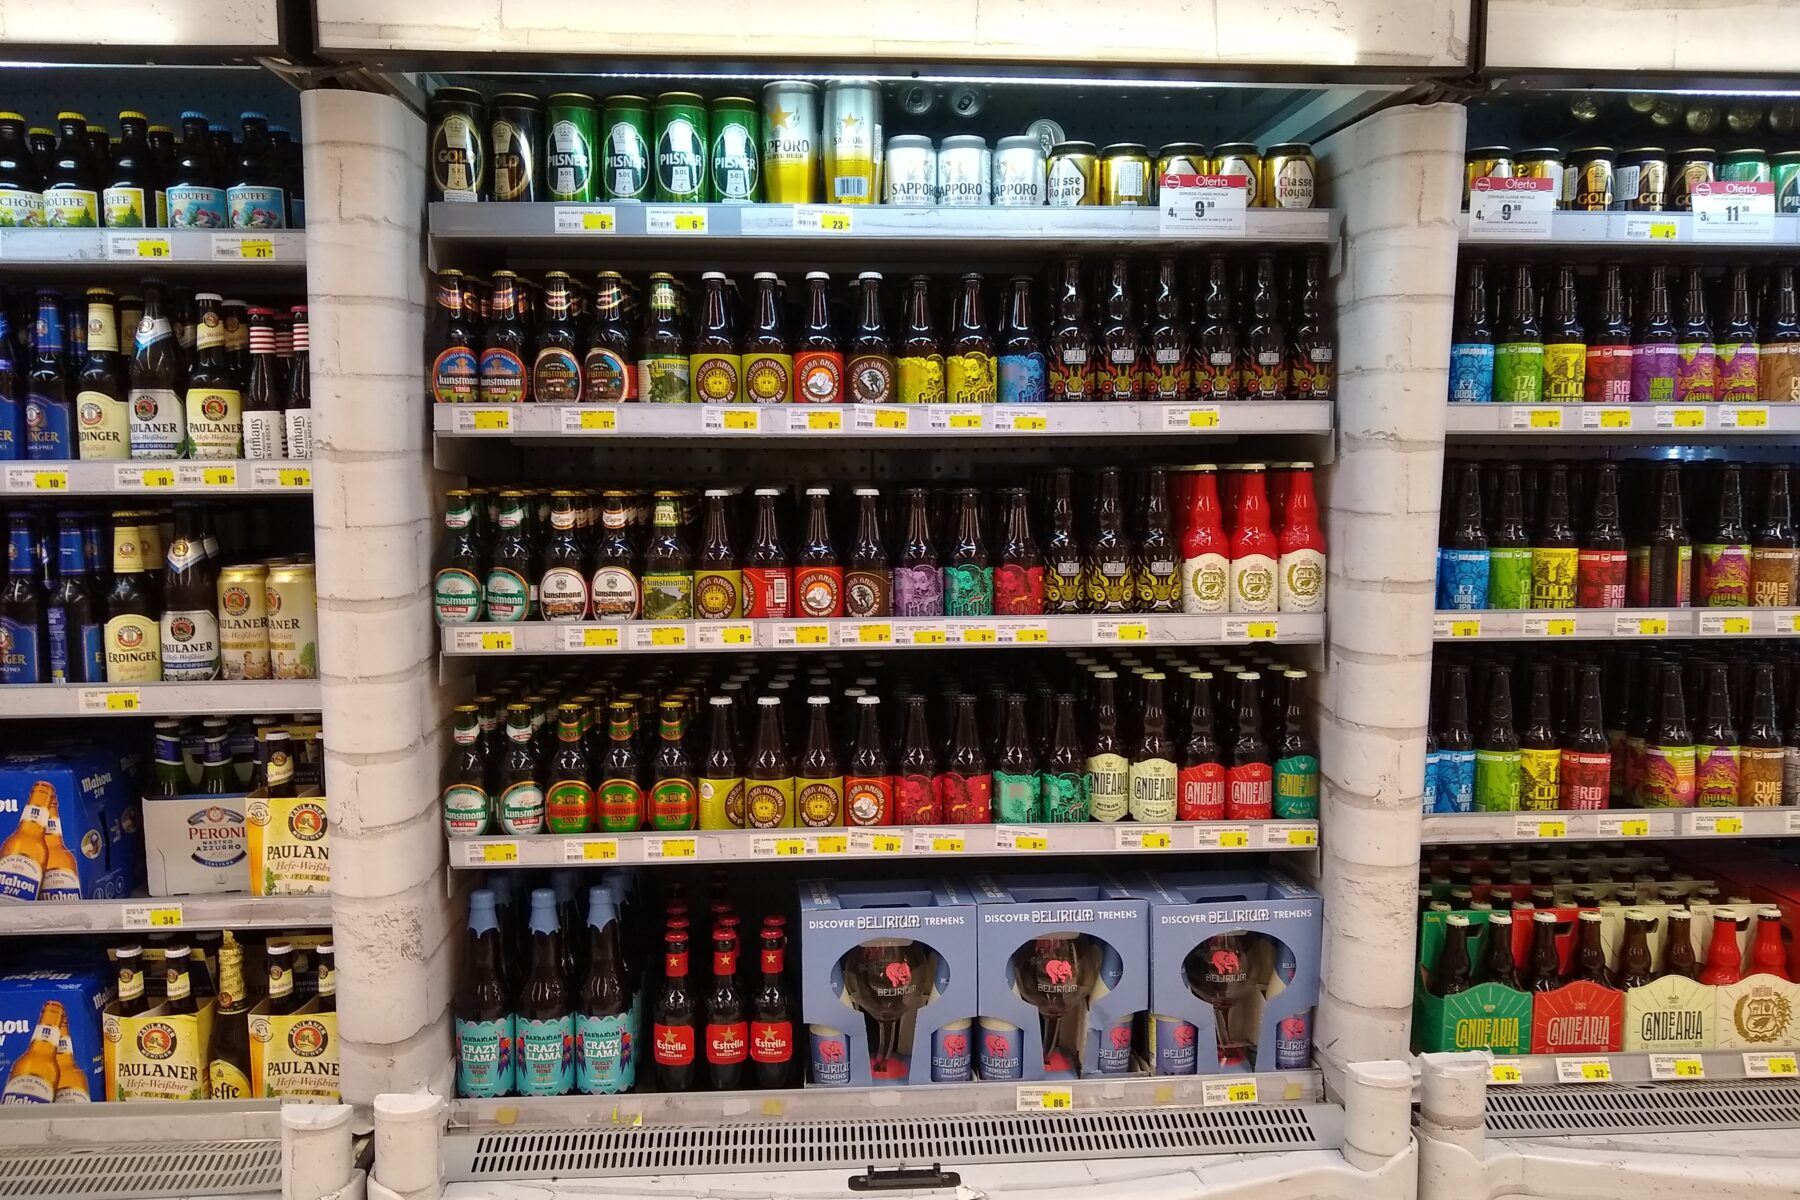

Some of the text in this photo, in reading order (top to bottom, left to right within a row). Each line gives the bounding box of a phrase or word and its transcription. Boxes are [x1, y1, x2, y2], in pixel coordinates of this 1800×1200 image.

[660, 155, 702, 167] PILSNER
[1196, 176, 1228, 186] Oferta
[1279, 176, 1313, 187] Classe
[1506, 178, 1536, 189] Oferta
[1279, 187, 1313, 199] Royale
[1726, 183, 1757, 193] Oferta
[1578, 193, 1613, 205] GOLD
[1459, 379, 1473, 389] K-7
[1514, 376, 1536, 389] 174
[1614, 380, 1630, 393] RED
[655, 513, 673, 522] IPA
[543, 590, 583, 600] kunstmann
[595, 589, 633, 599] kunstmann
[1458, 585, 1473, 594] K-7
[108, 652, 158, 663] ERDINGER
[82, 772, 112, 793] Mahou
[1580, 786, 1602, 800] RED
[188, 827, 246, 840] PERONI
[4, 886, 20, 896] SIN
[984, 909, 1137, 924] DISCOVER DELIRIUM TREMENS
[1161, 909, 1312, 924] DISCOVER DELIRIUM TREMENS
[808, 915, 965, 930] DISCOVER DELIRIUM TREMENS
[1547, 1015, 1610, 1046] CANDELARIA
[1641, 1010, 1703, 1041] CANDELARIA
[1455, 1017, 1519, 1049] CANDELARIA
[463, 1043, 497, 1054] CRAZY
[526, 1043, 562, 1053] CRAZY
[585, 1040, 620, 1051] CRAZY
[656, 1040, 688, 1052] Estrella
[713, 1040, 745, 1051] Estrella
[755, 1038, 787, 1050] Estrella
[463, 1052, 497, 1062] LLAMA
[526, 1052, 562, 1062] LLAMA
[585, 1048, 620, 1058] LLAMA
[119, 1063, 198, 1081] PAULANER
[941, 1068, 967, 1076] TREMENS
[985, 1067, 1010, 1075] TREMENS
[126, 1079, 188, 1092] Hefe-Weißbier
